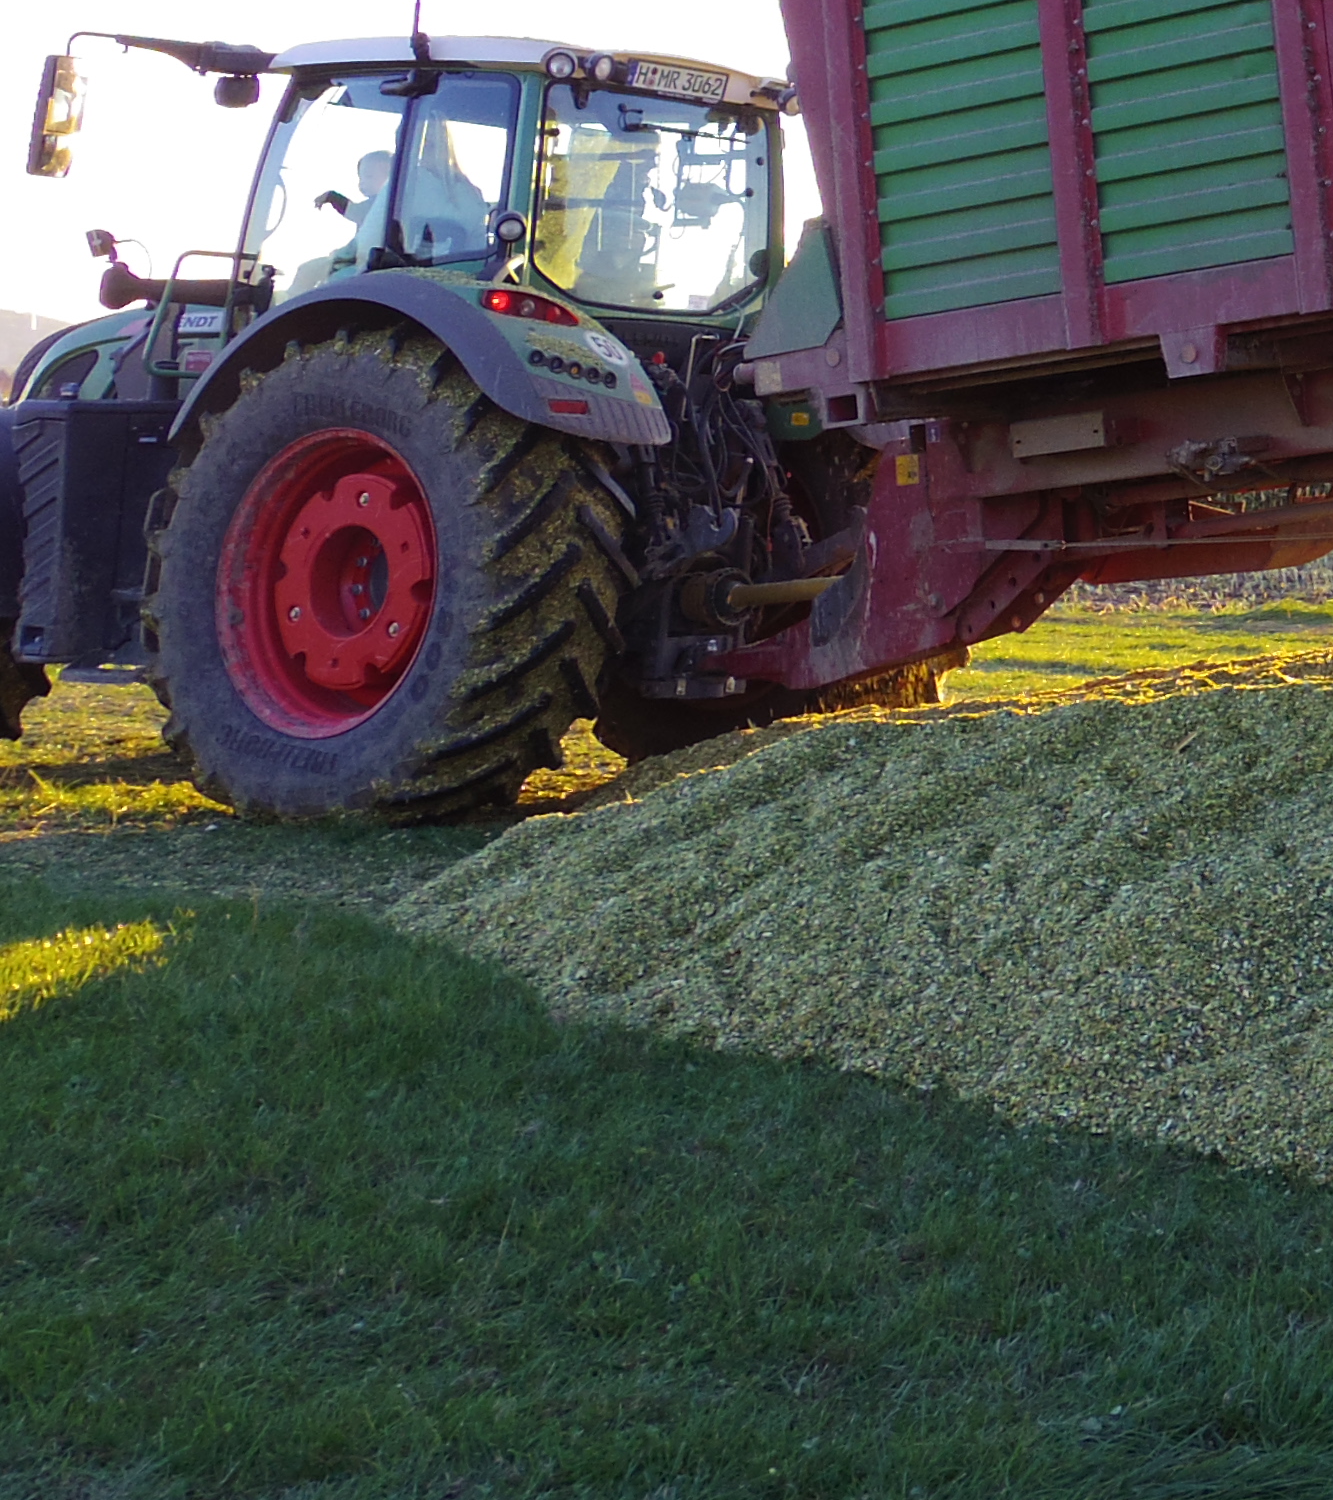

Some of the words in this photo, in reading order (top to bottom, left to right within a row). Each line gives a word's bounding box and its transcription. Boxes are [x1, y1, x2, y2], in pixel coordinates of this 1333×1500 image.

[635, 65, 650, 85] H
[657, 69, 682, 90] MR
[682, 72, 724, 97] 3062
[590, 336, 624, 361] 50
